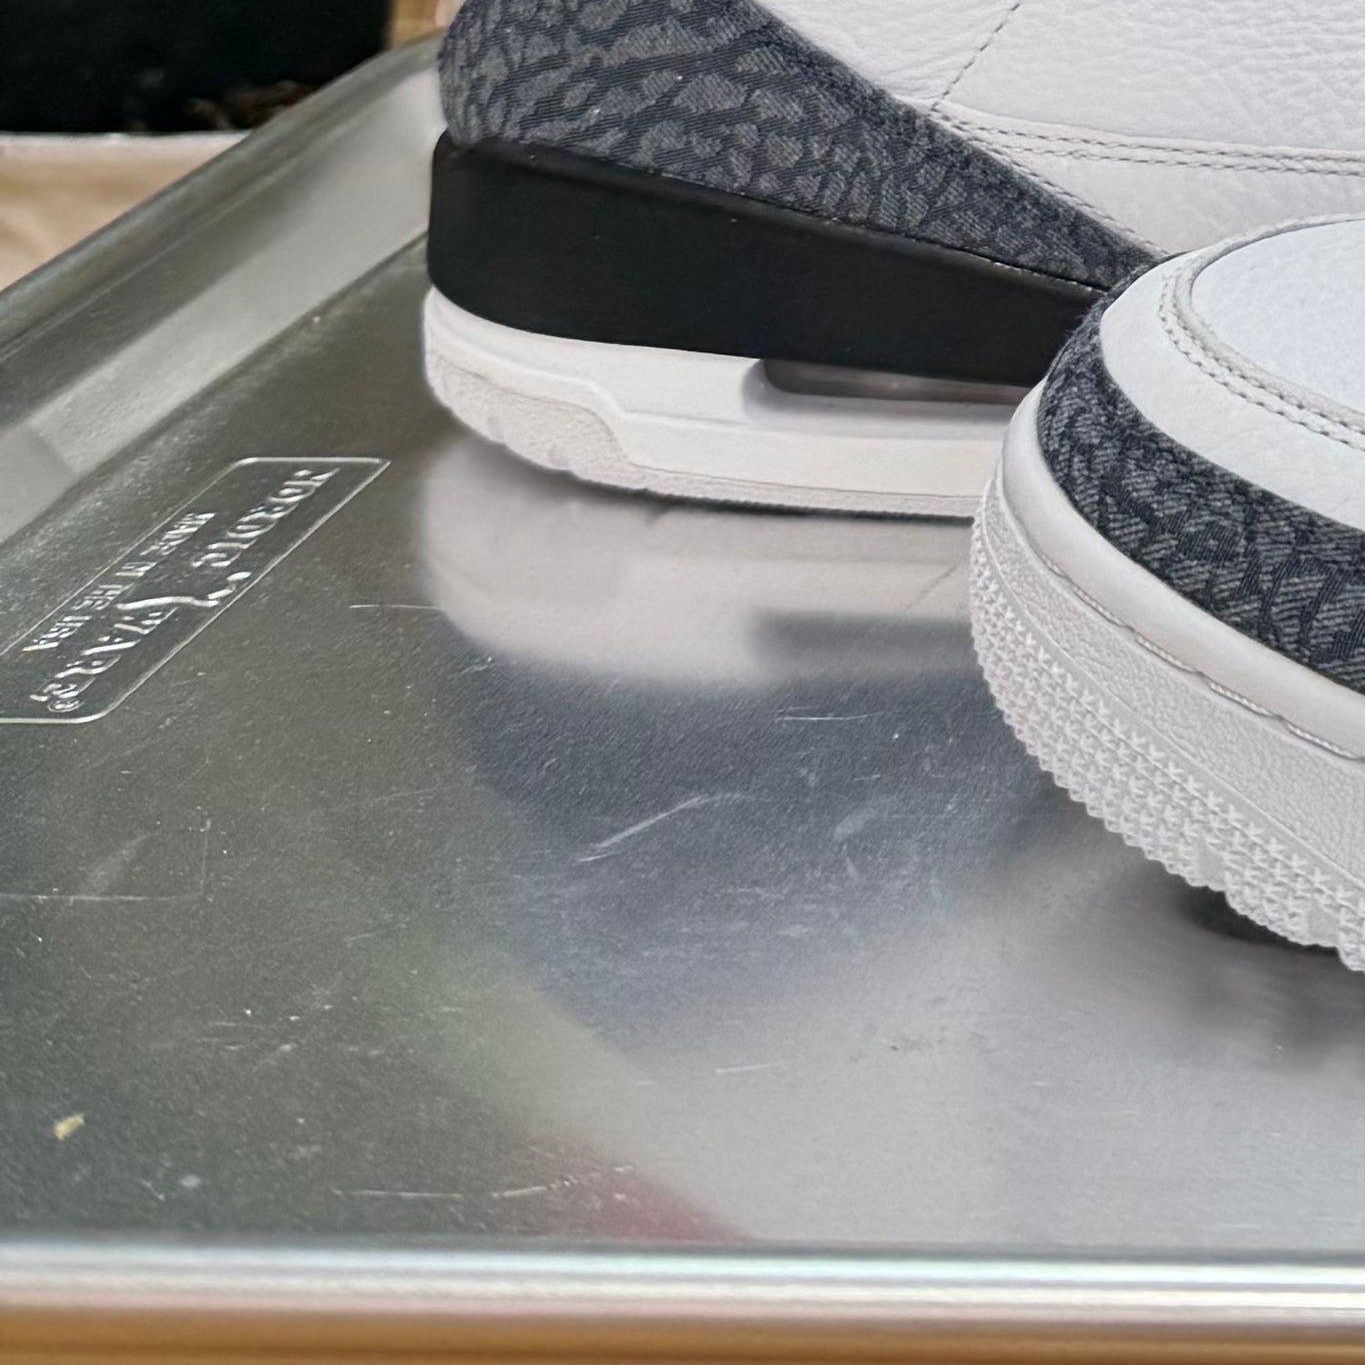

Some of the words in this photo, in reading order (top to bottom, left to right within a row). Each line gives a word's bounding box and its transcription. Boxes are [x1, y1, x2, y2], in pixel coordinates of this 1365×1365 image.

[140, 512, 216, 555] MADE
[191, 469, 340, 568] NORDIC
[115, 562, 157, 577] IN
[71, 583, 135, 610] THE
[23, 616, 91, 652] USA
